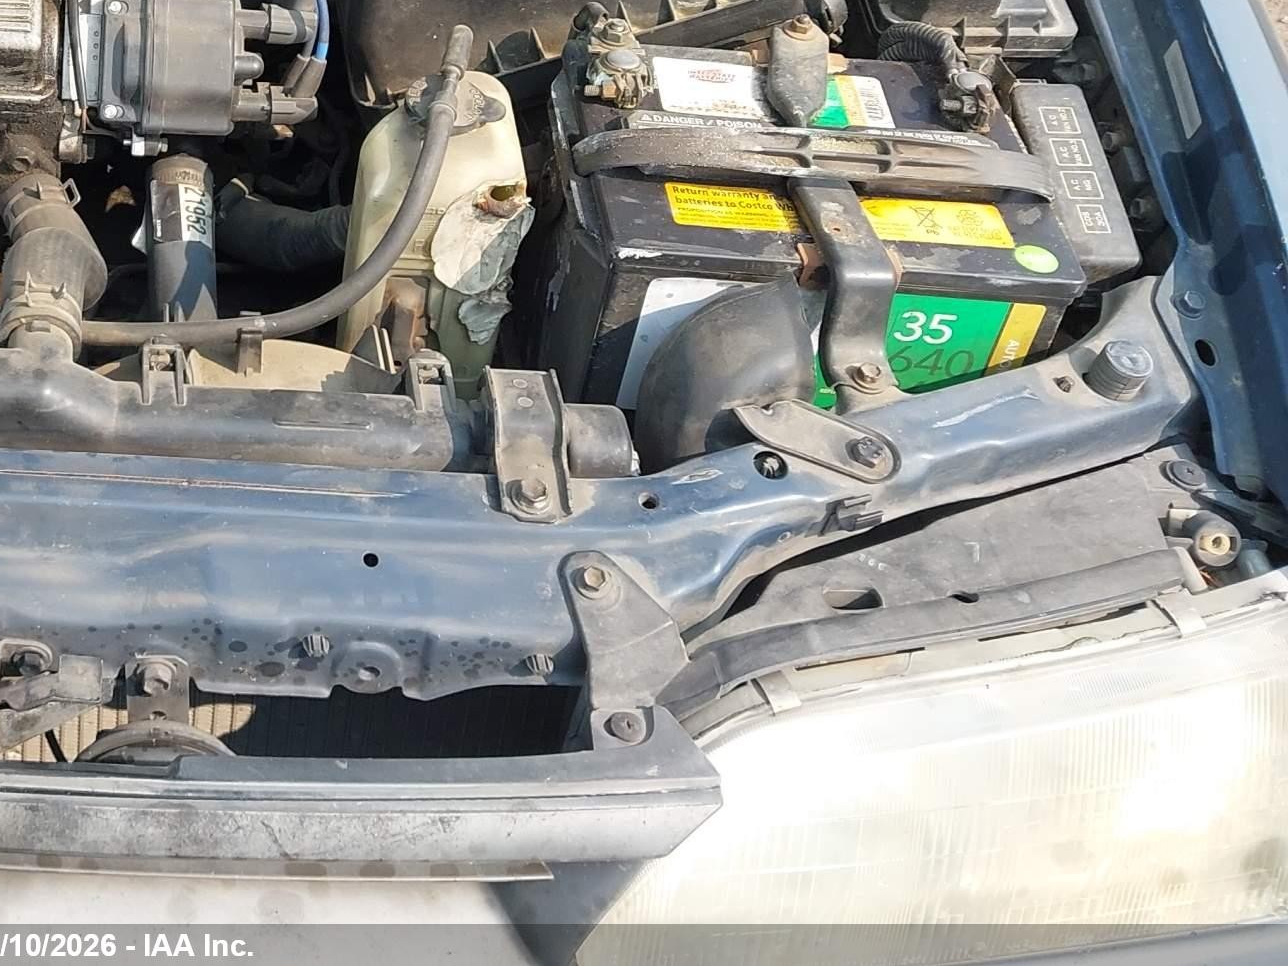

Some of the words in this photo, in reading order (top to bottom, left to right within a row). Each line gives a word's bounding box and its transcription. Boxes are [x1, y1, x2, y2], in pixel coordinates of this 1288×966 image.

[652, 115, 705, 126] DANGER
[672, 186, 709, 196] Return
[712, 191, 760, 201] warranty
[675, 196, 724, 208] batteries
[738, 202, 774, 211] Costco
[184, 186, 207, 236] 21952
[892, 310, 958, 345] 35
[888, 345, 974, 378] 640
